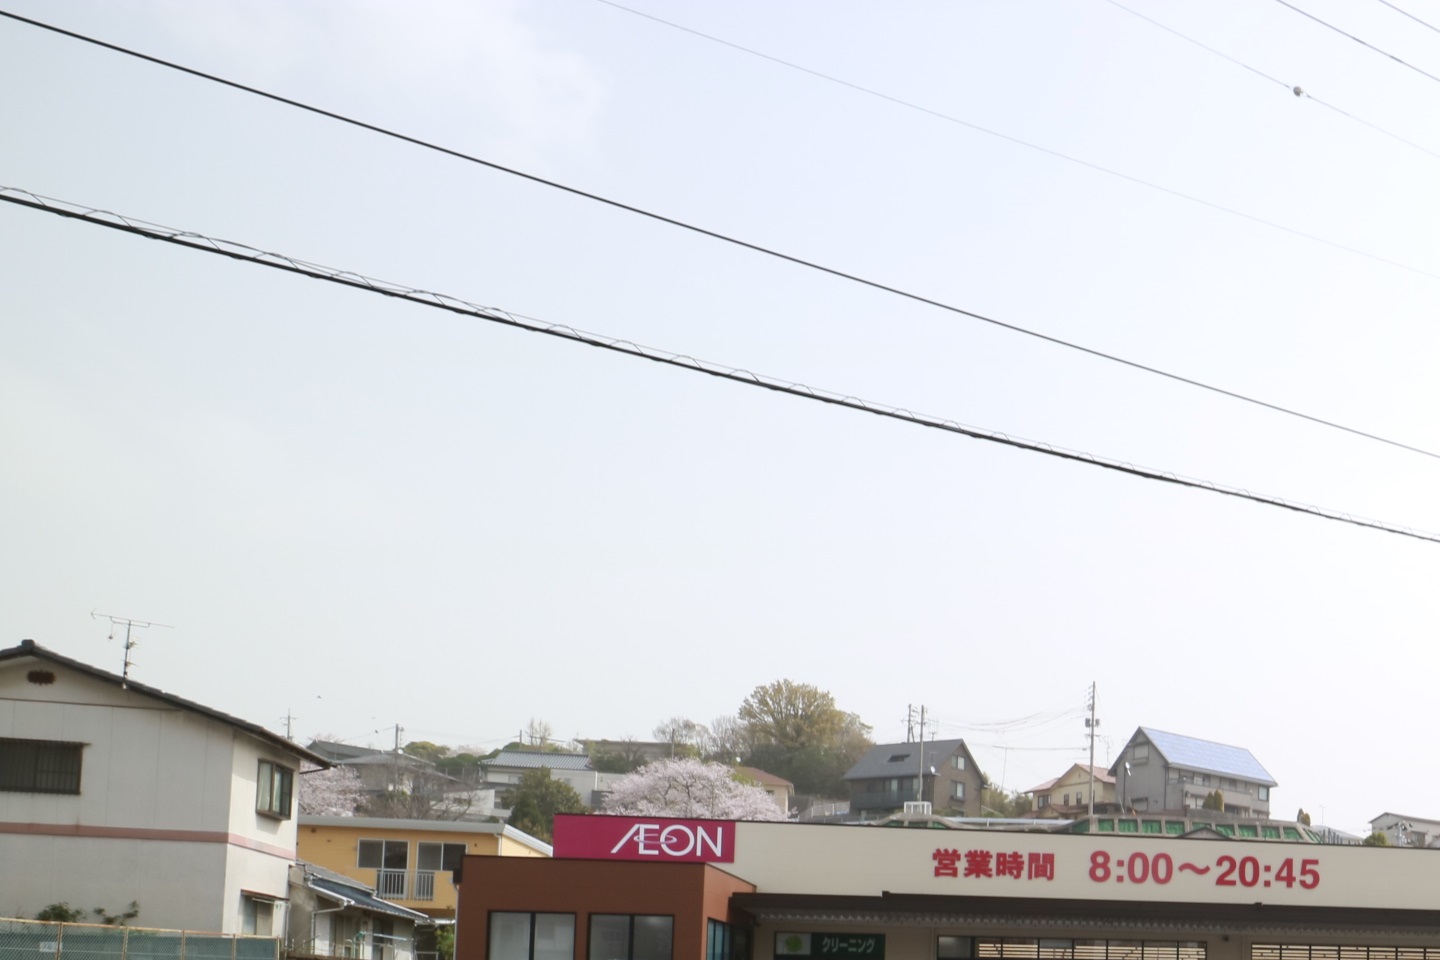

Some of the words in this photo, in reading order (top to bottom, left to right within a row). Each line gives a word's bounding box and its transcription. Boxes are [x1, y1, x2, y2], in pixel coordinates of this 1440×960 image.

[932, 847, 1056, 882] 営業時間
[821, 936, 876, 954] クリーニング
